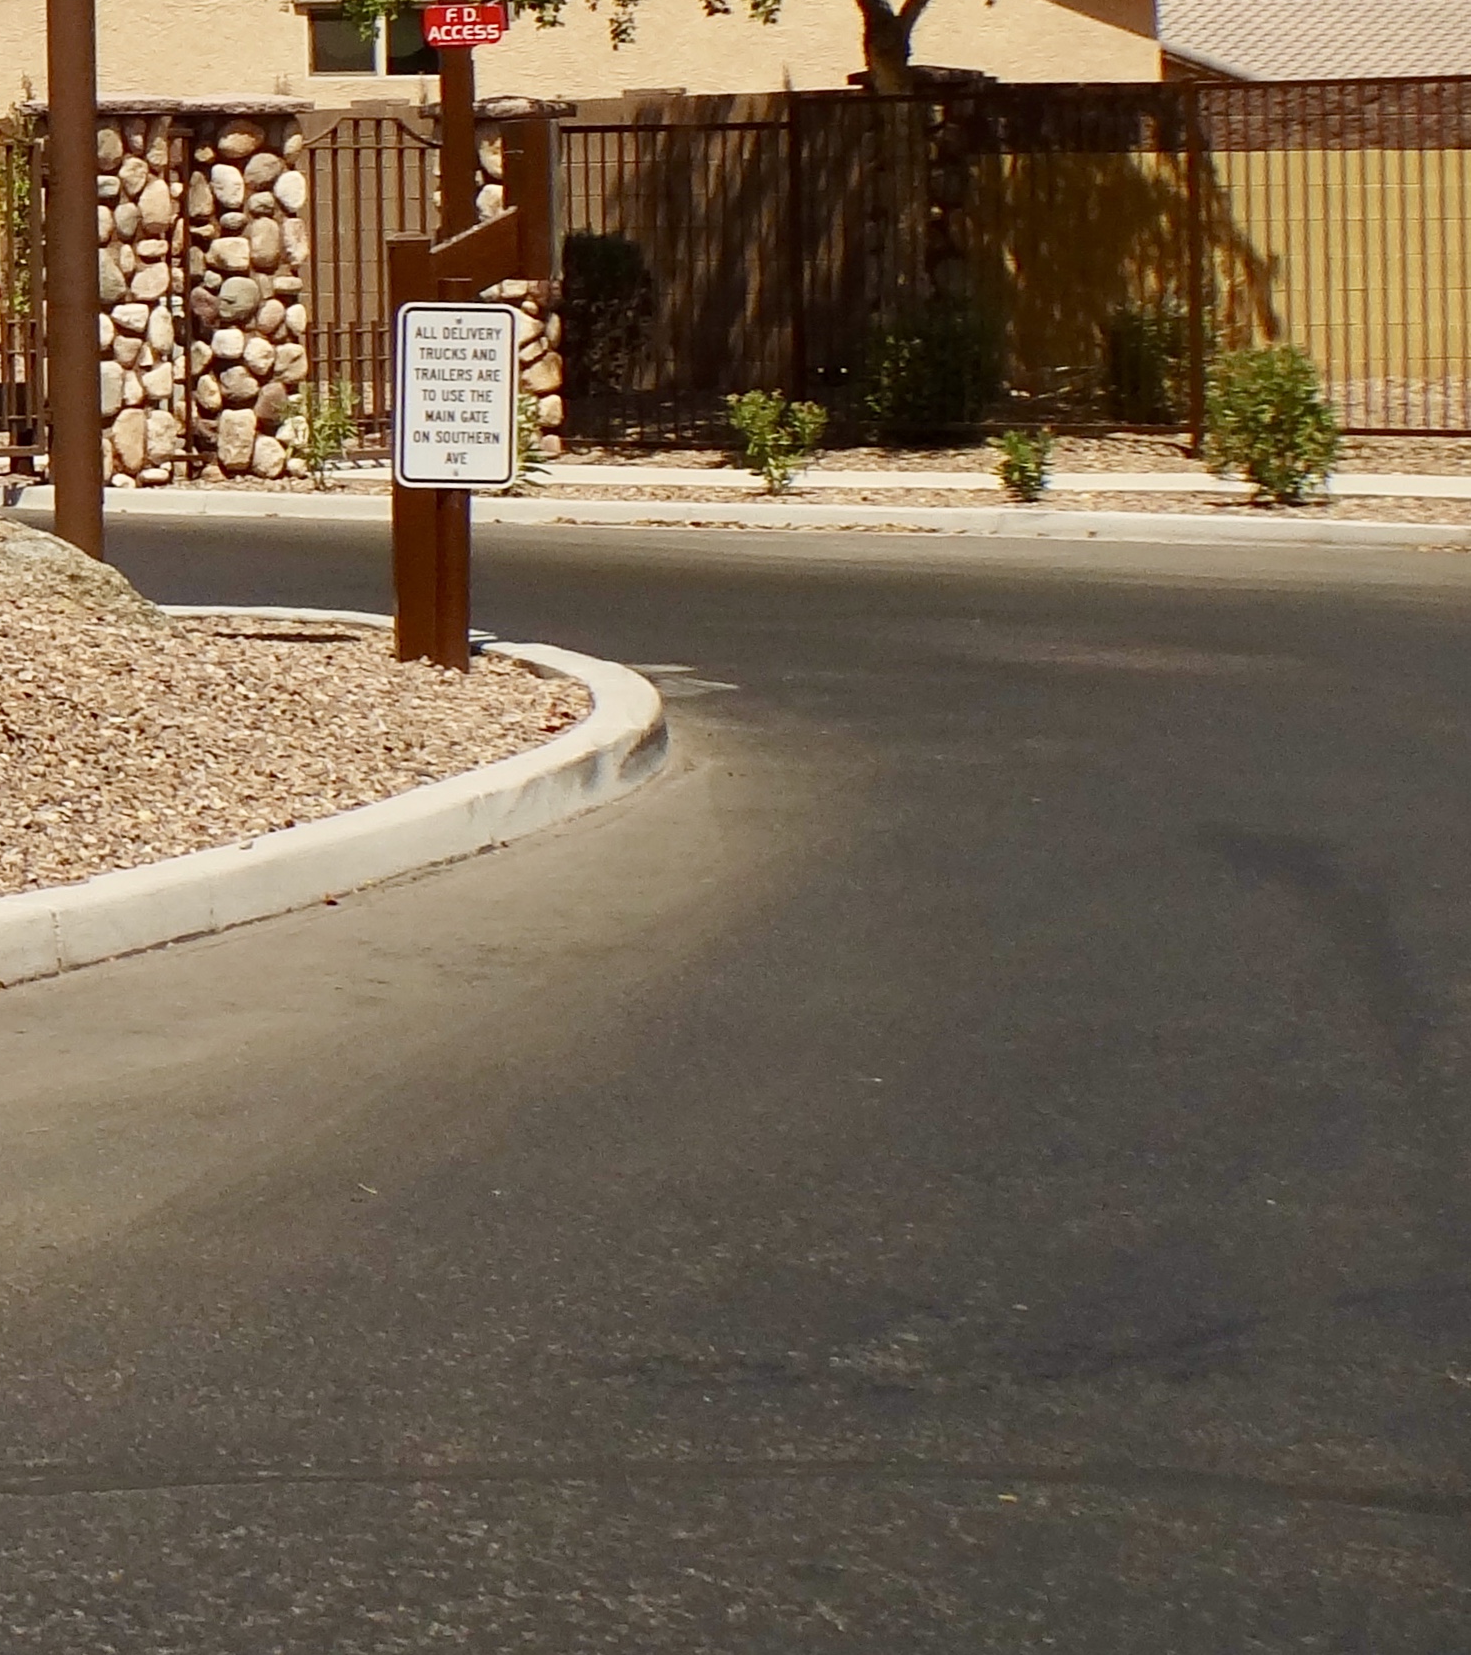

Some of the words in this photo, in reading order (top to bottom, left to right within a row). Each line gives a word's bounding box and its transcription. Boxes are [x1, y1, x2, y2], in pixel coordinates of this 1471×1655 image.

[427, 24, 500, 41] ACCESS
[415, 327, 437, 340] ALL
[443, 327, 502, 341] DELIVERY
[419, 348, 467, 361] TRUCKS
[472, 349, 497, 362] AND
[414, 368, 473, 382] TRAILERS
[477, 369, 501, 383] ARE
[421, 389, 437, 403] TO
[441, 389, 465, 403] USE
[469, 389, 493, 404] THE
[425, 410, 455, 424] MAIN
[460, 411, 489, 425] GATE
[413, 431, 430, 444] ON
[435, 431, 500, 445] SOUTHERN
[445, 452, 468, 466] AVE
